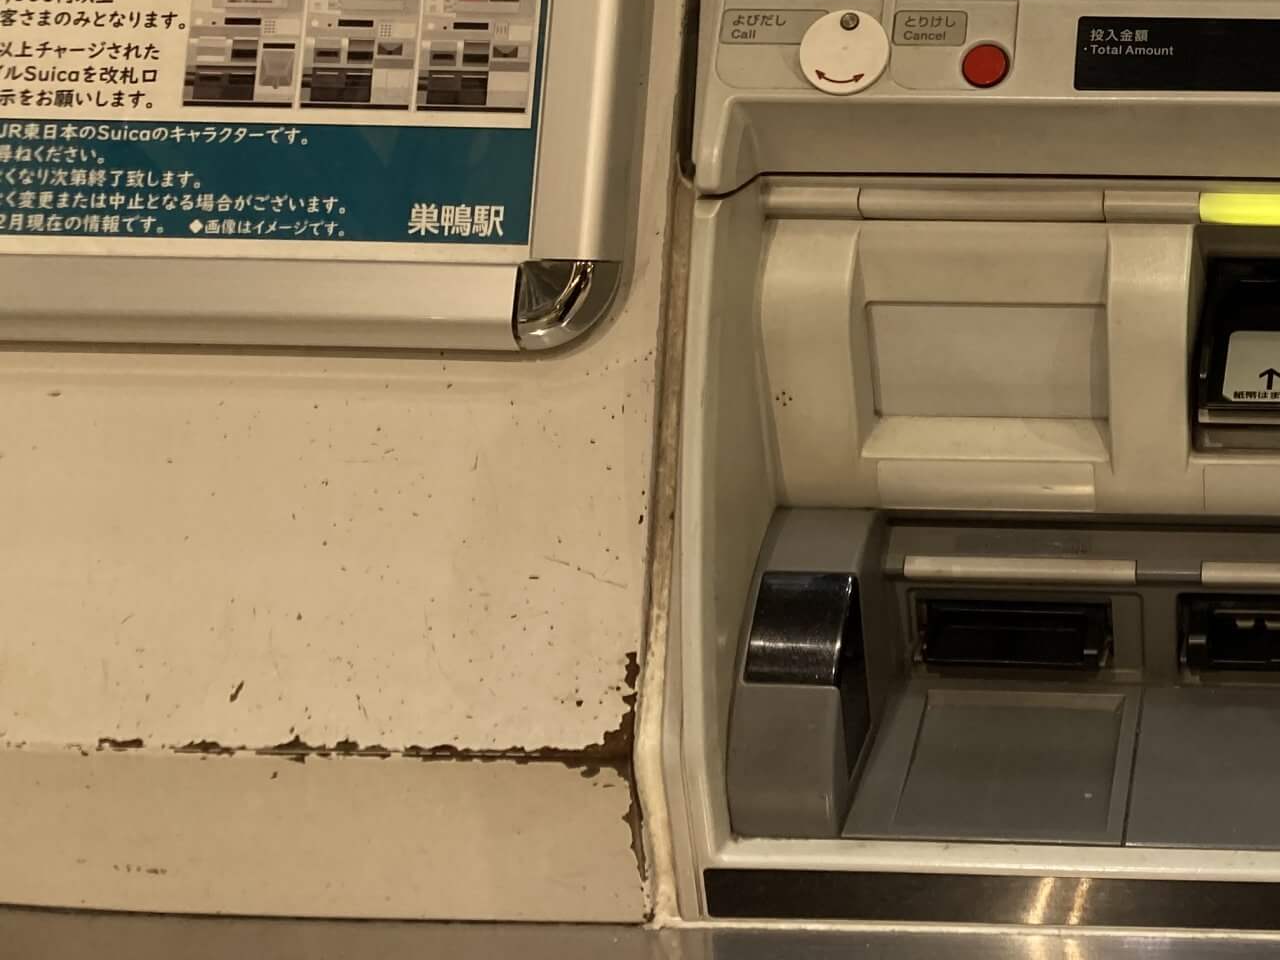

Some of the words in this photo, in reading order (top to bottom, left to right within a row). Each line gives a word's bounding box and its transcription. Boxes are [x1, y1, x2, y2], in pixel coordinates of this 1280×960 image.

[732, 15, 786, 27] よびだし
[903, 16, 956, 28] とりけし
[731, 29, 756, 40] Call
[903, 30, 947, 41] Cancel
[1089, 29, 1149, 43] 投入金額
[1090, 44, 1123, 56] Total
[1125, 45, 1174, 57] Amount
[0, 65, 158, 85] ルSuicaを改札口
[0, 167, 201, 189] くなり次第終了致します。
[0, 191, 347, 216] く変更または中止となる場合がございます。
[408, 203, 505, 238] 巣鴨駅
